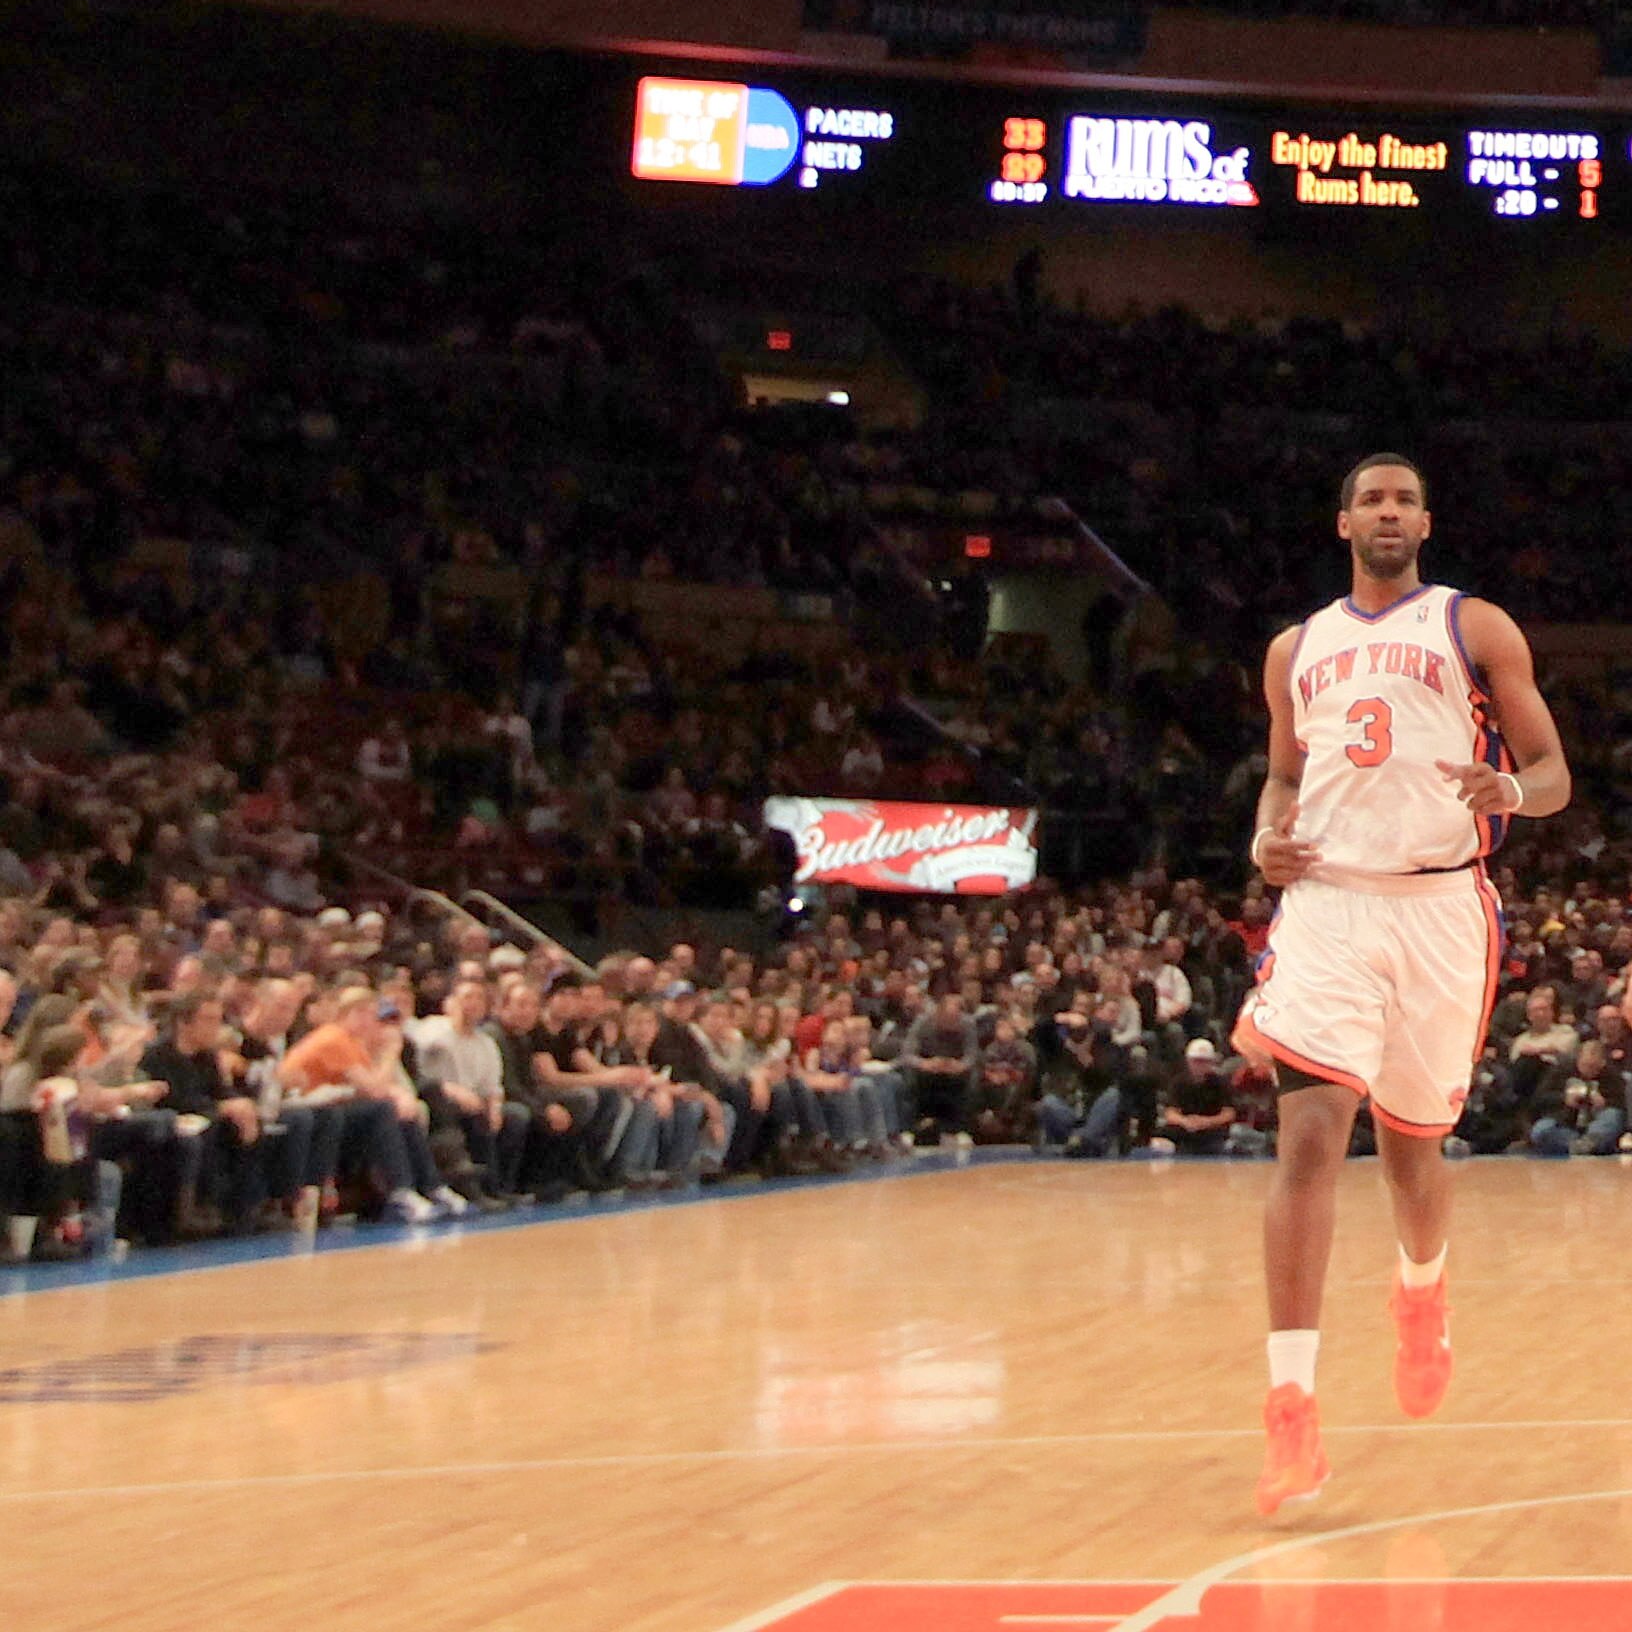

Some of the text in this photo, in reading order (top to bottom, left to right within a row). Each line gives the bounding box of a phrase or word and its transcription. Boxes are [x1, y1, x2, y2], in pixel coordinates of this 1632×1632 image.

[808, 107, 893, 139] PACERS
[804, 142, 862, 170] NETS
[1272, 132, 1447, 171] Enjoy the finest
[1469, 132, 1599, 160] TIMEOUTS
[1211, 148, 1249, 180] of
[1469, 160, 1536, 186] FULL
[1579, 160, 1601, 187] 5
[1066, 176, 1227, 202] PUERTO RICO
[1297, 172, 1420, 207] Rums here.
[1579, 192, 1598, 218] 1
[1297, 642, 1446, 712] NEW YORK
[1345, 697, 1393, 768] 3
[793, 808, 1010, 882] Budweiser
